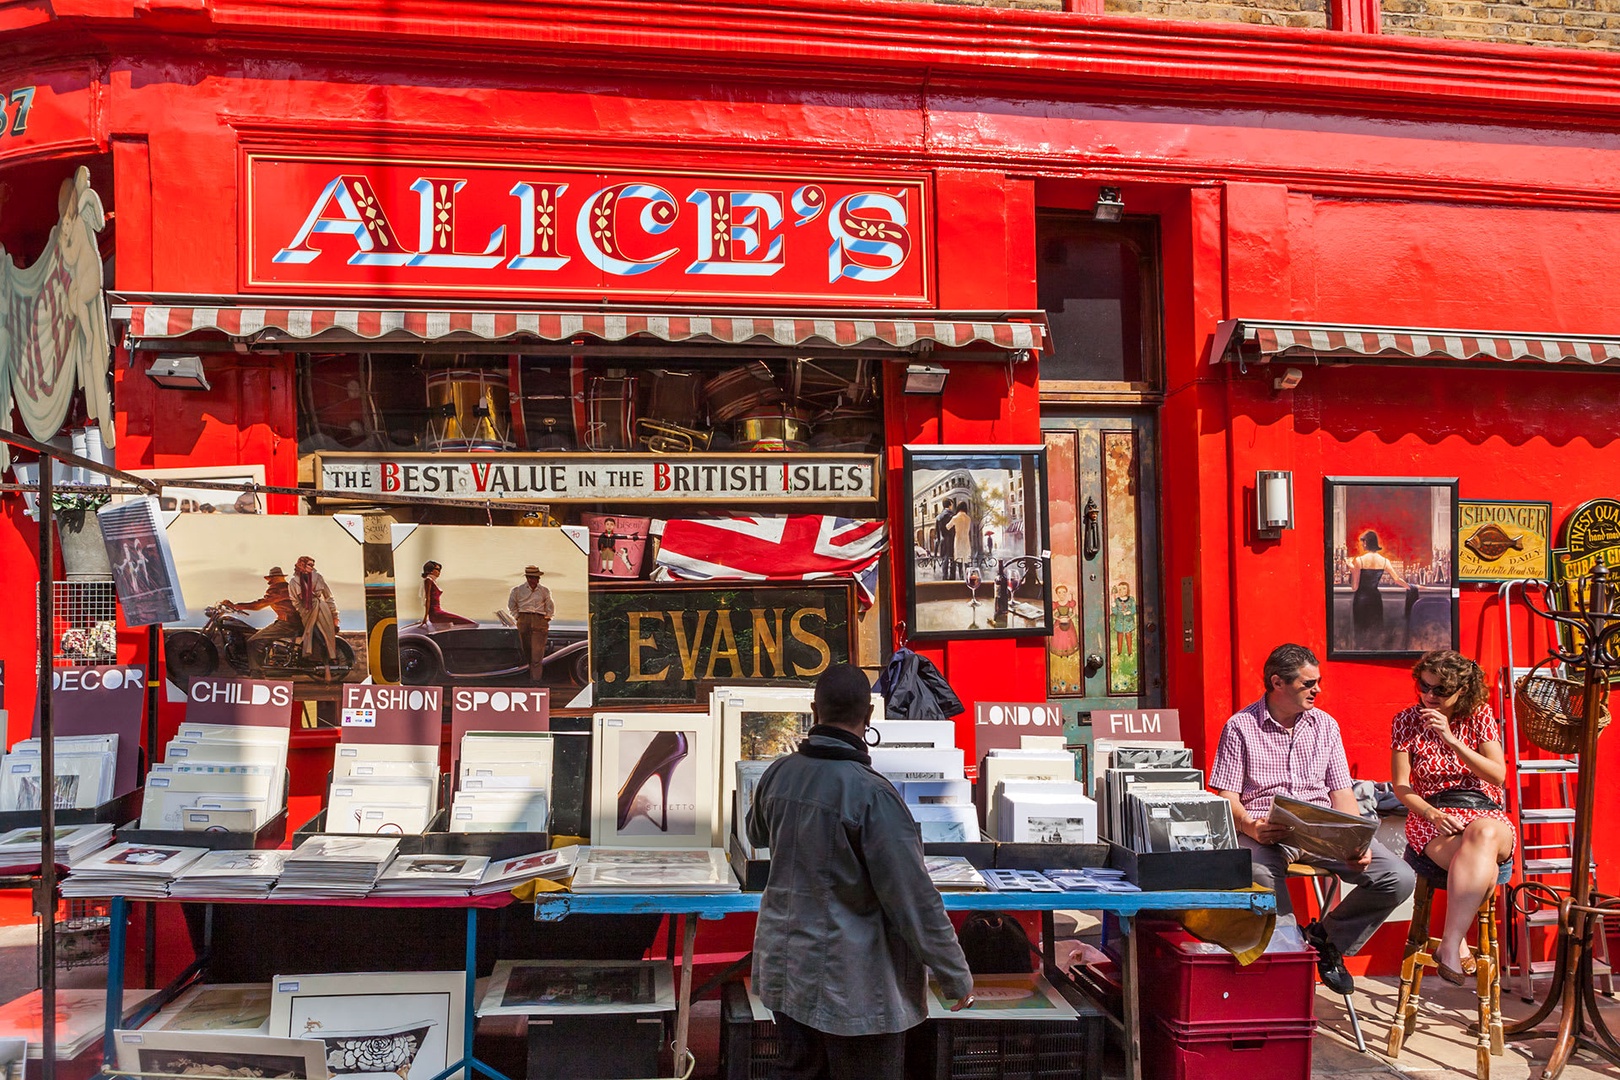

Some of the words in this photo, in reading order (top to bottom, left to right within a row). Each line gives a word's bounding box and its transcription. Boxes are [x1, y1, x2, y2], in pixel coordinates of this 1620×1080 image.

[272, 174, 912, 284] ALICE'S
[332, 471, 372, 488] THE
[380, 462, 459, 492] BEST
[470, 462, 568, 492] VALUE
[578, 470, 596, 487] IN
[606, 470, 644, 487] THE
[653, 462, 768, 491] BRITISH
[782, 462, 864, 491] ISLES
[1459, 506, 1546, 538] ISHMONGER
[1571, 509, 1595, 552] FINEST
[1595, 505, 1620, 528] QUA
[1460, 551, 1480, 565] ESH
[1508, 549, 1541, 566] DAILY
[191, 681, 290, 707] CHILDS
[348, 688, 438, 711] FASHION
[456, 691, 547, 712] SPORT
[975, 705, 1060, 727] LONDON
[1110, 713, 1161, 734] FILM
